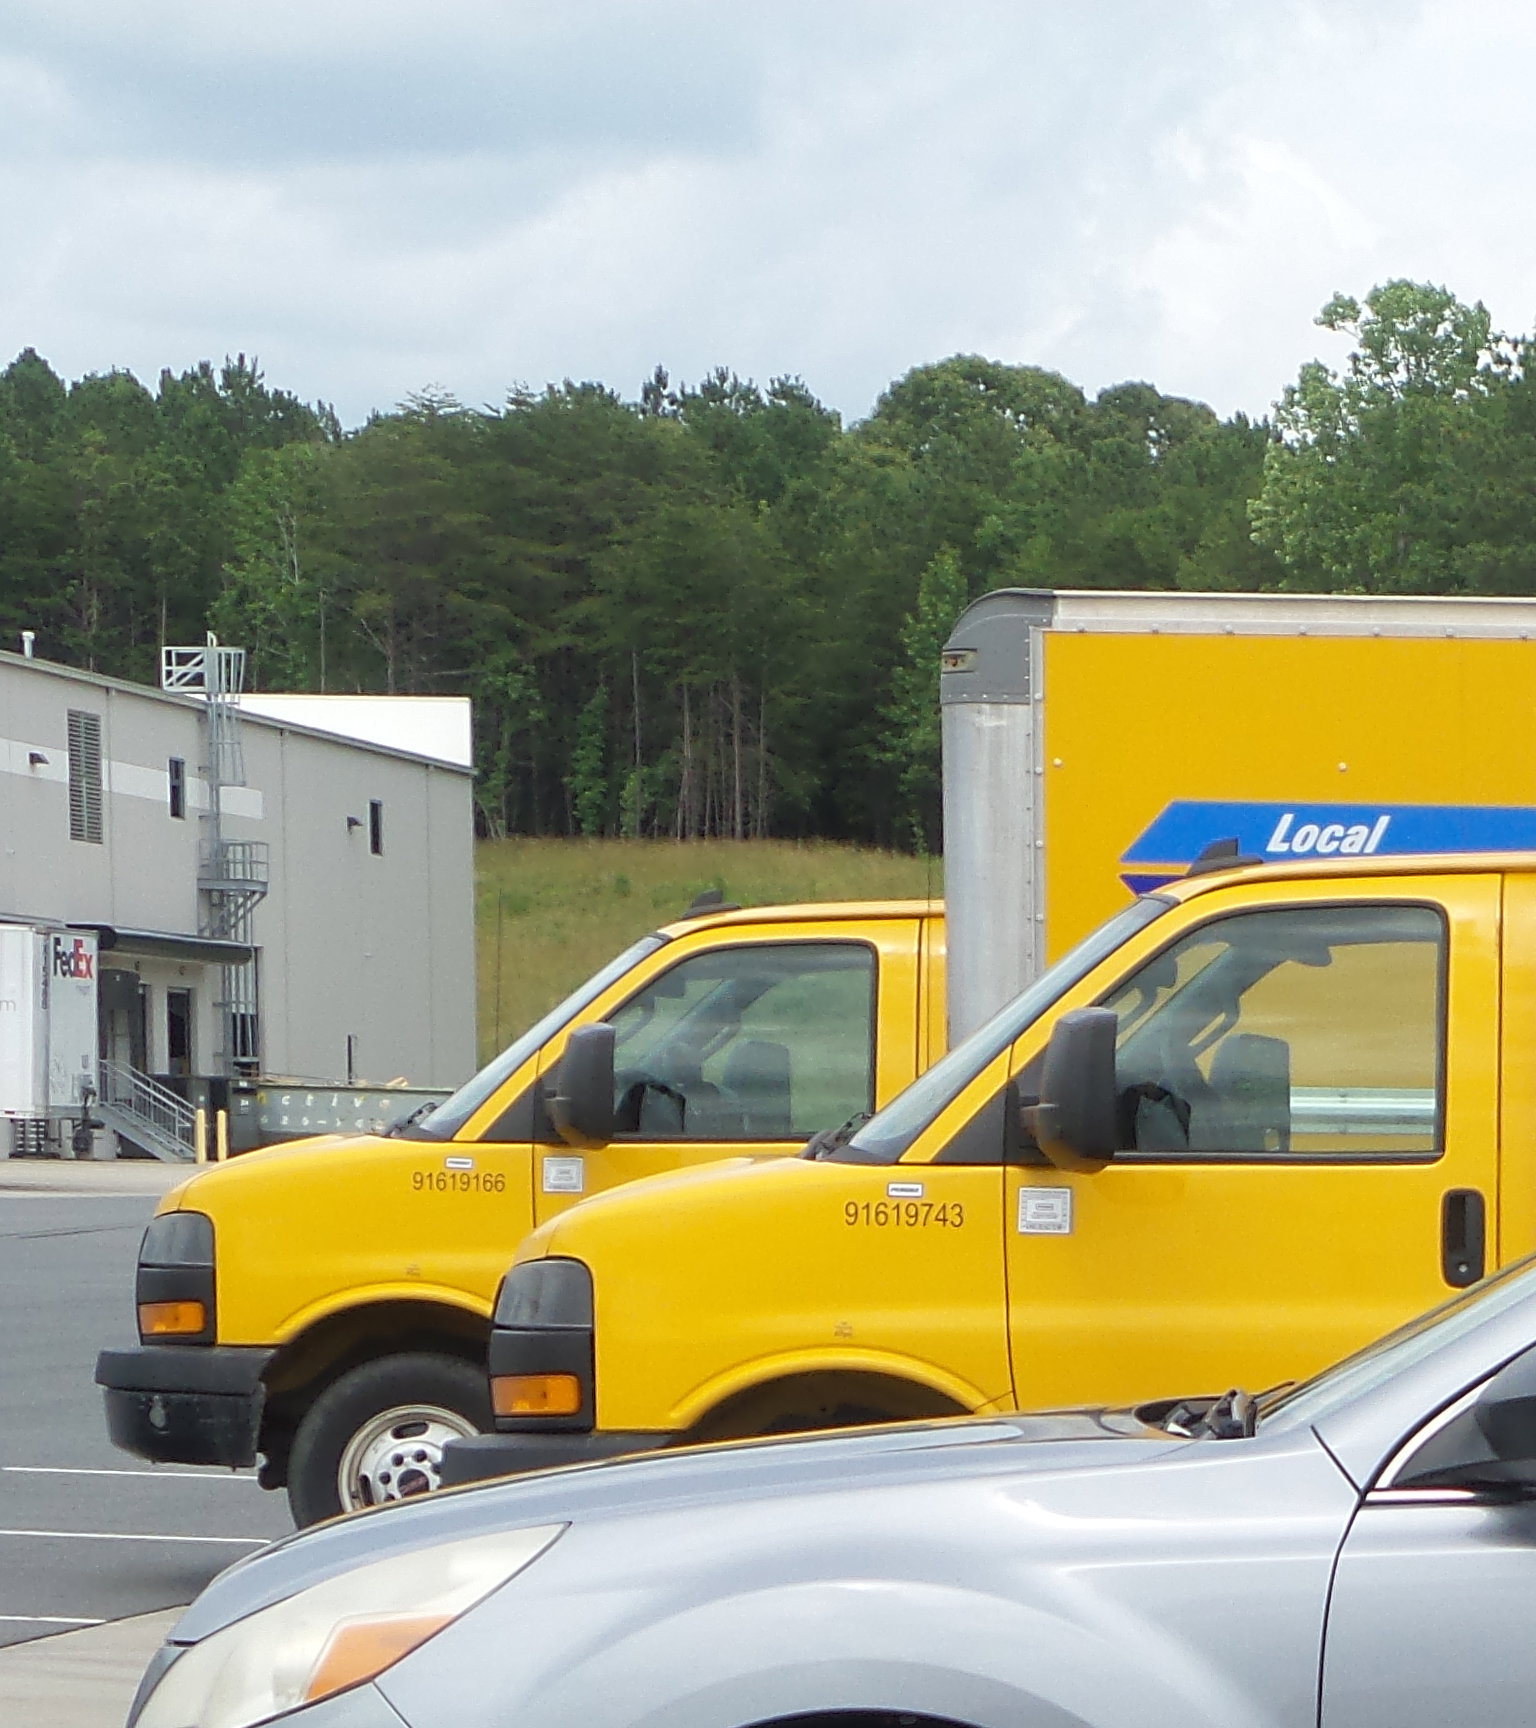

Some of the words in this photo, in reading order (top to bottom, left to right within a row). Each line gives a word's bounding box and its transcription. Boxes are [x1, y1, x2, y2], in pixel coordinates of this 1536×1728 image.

[1265, 812, 1391, 854] Local
[52, 936, 93, 979] FedEx
[412, 1171, 506, 1193] 91619166
[844, 1201, 965, 1228] 91619743
